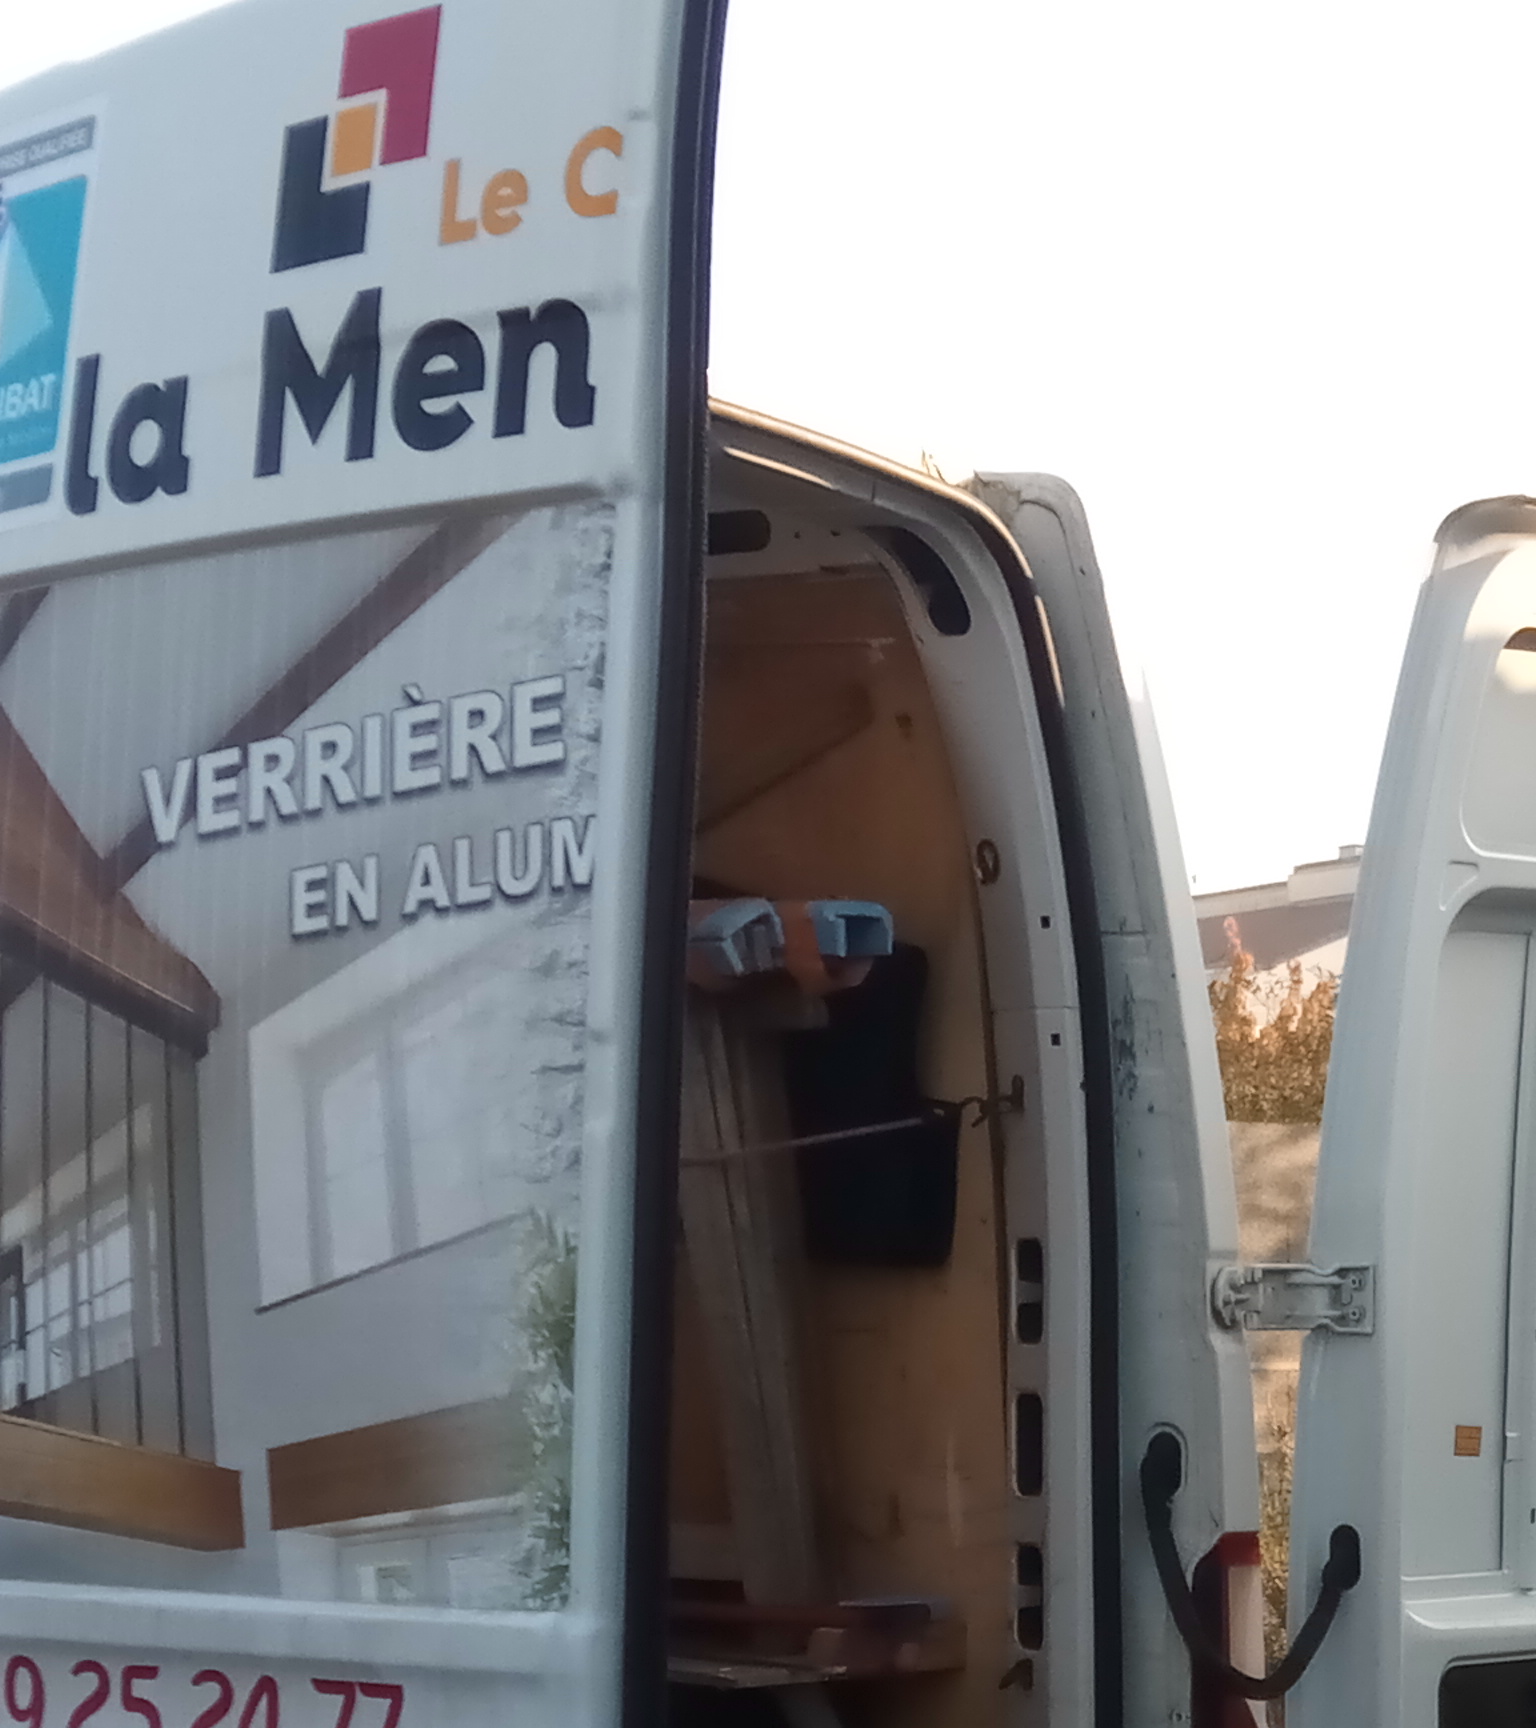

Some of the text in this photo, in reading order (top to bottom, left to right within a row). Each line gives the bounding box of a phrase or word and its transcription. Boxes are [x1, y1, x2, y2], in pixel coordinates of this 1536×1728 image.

[438, 125, 624, 246] Le C
[65, 286, 596, 515] la Men
[142, 675, 565, 845] VERRIÈRE
[290, 854, 379, 937] EN
